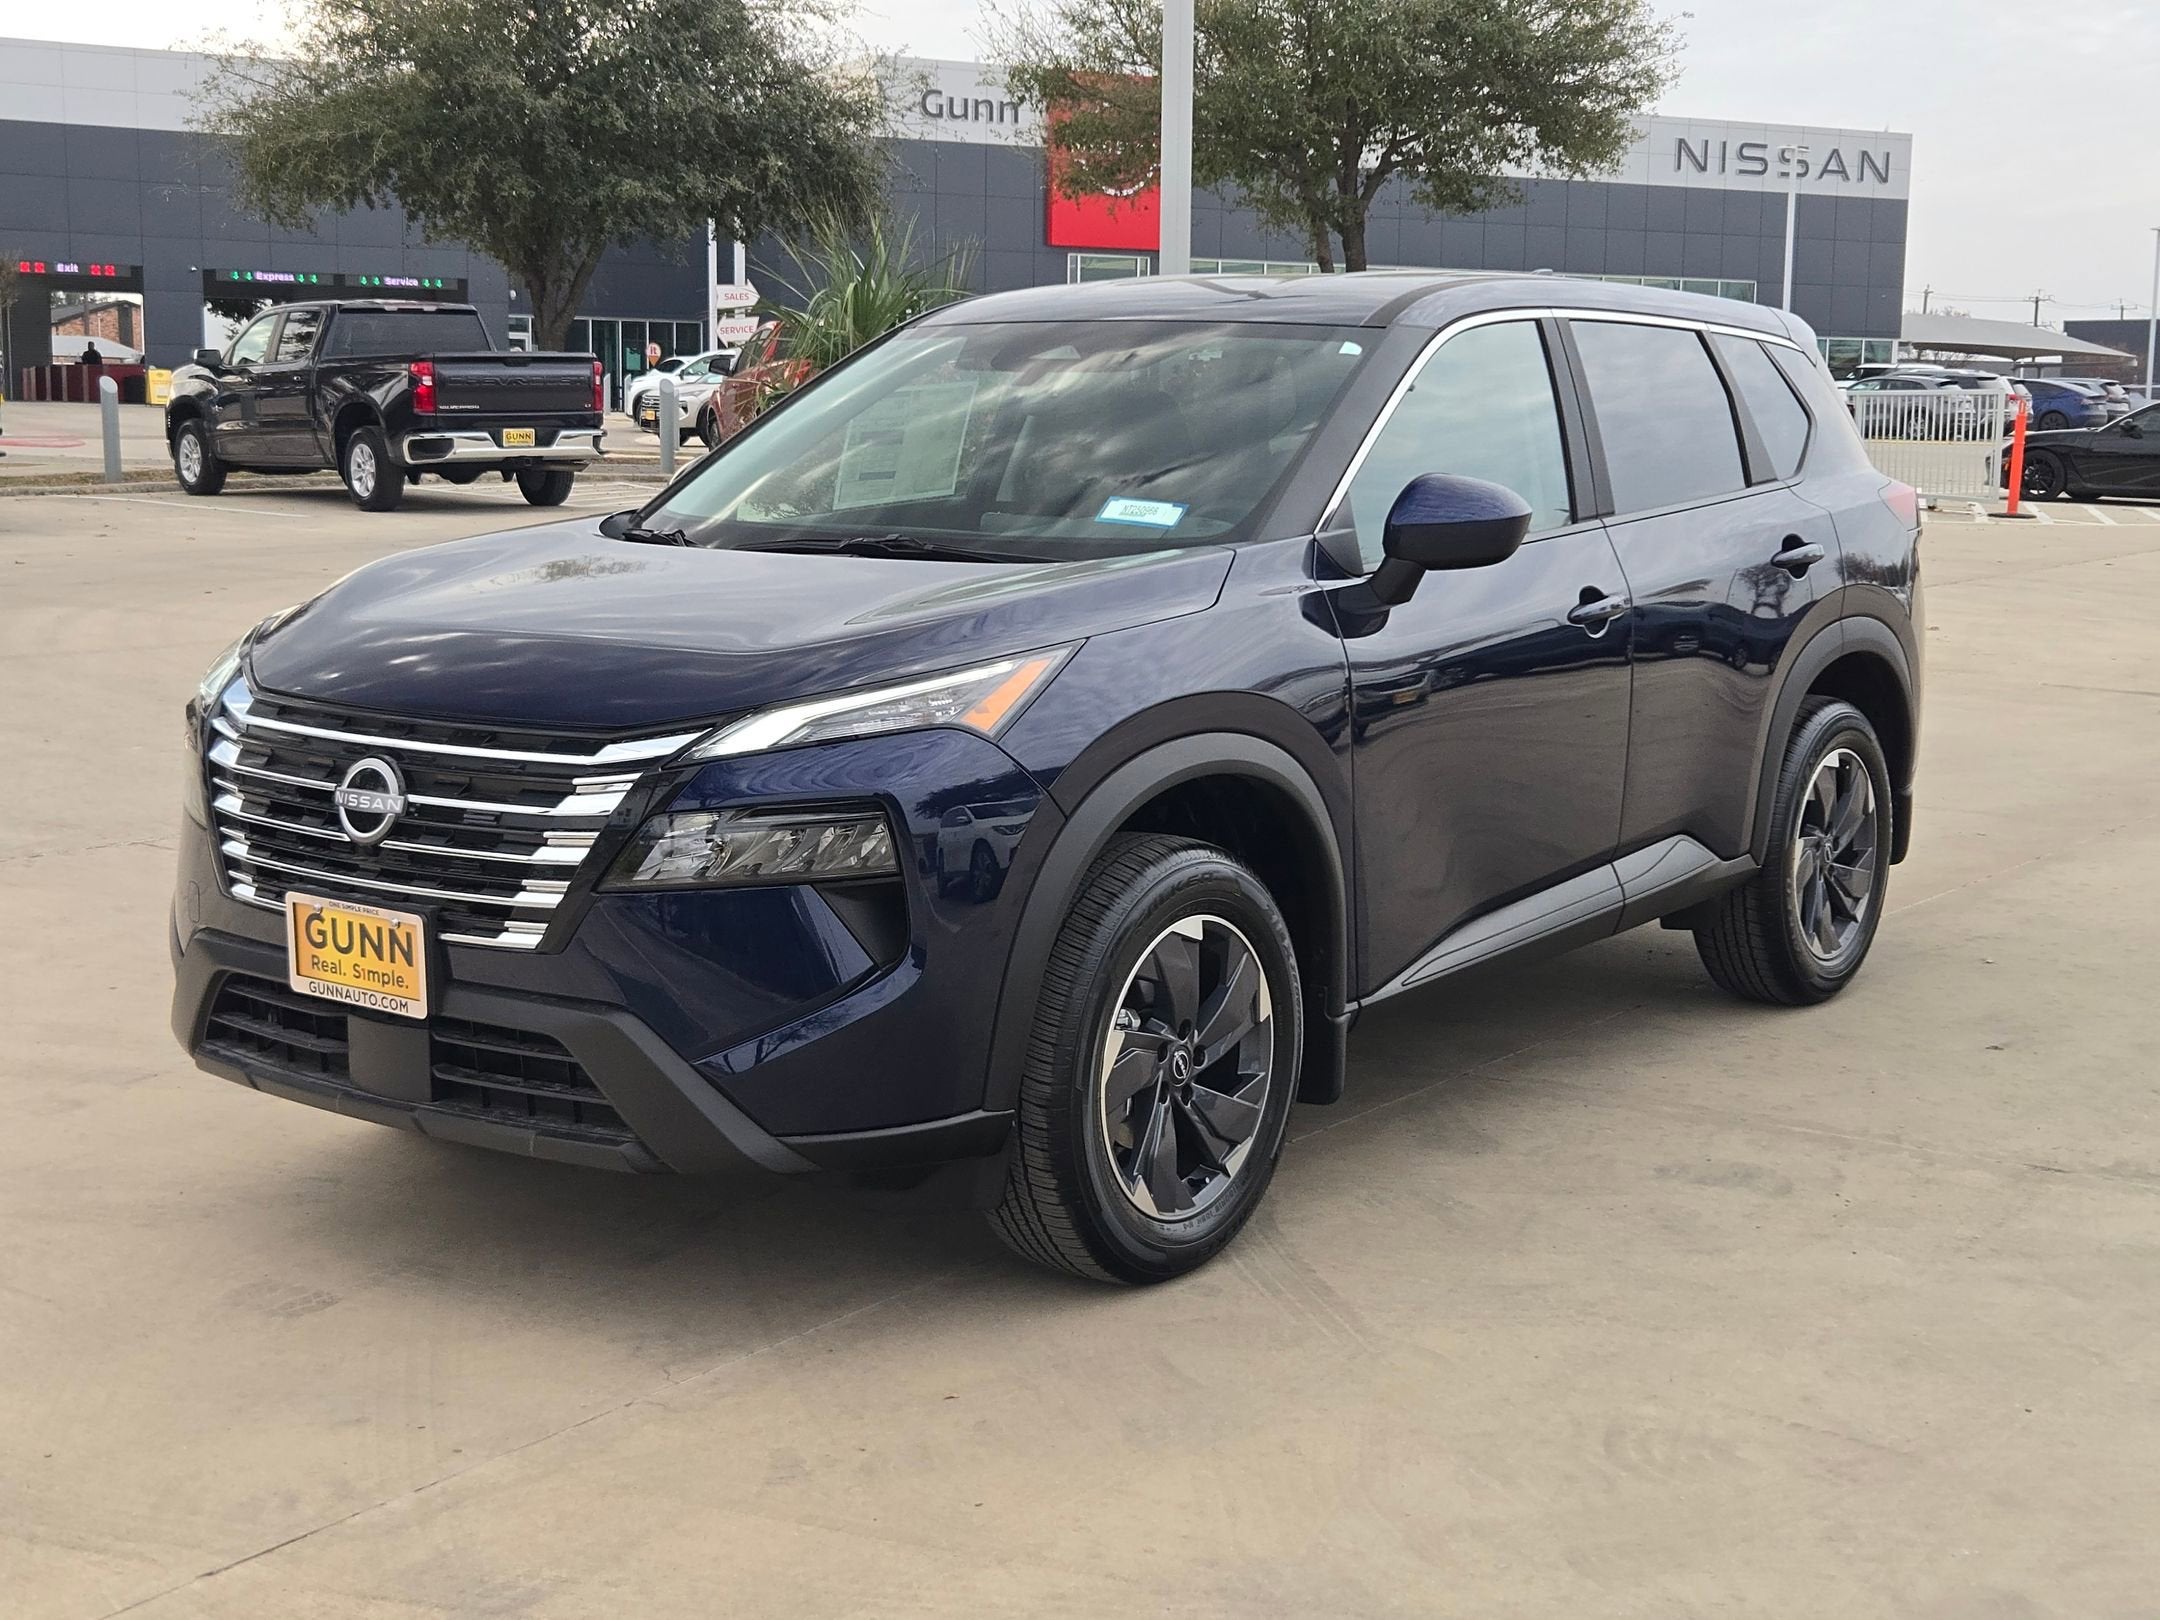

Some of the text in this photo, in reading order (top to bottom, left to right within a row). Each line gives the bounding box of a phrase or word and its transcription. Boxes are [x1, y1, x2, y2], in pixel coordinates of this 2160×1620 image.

[921, 89, 1019, 124] Gunn
[1675, 137, 1891, 184] NISSAN
[56, 262, 79, 273] Exit
[254, 271, 295, 283] Express
[383, 276, 419, 287] Service
[724, 293, 750, 301] SALES
[720, 326, 755, 335] SERVICE
[506, 432, 532, 441] GUNN
[335, 790, 402, 811] NISSAN
[342, 904, 361, 912] SIMPLE
[362, 908, 380, 916] PRICE
[305, 913, 414, 967] GUNN
[311, 955, 347, 976] Real.
[308, 981, 409, 1013] GUNNAUTO.COM
